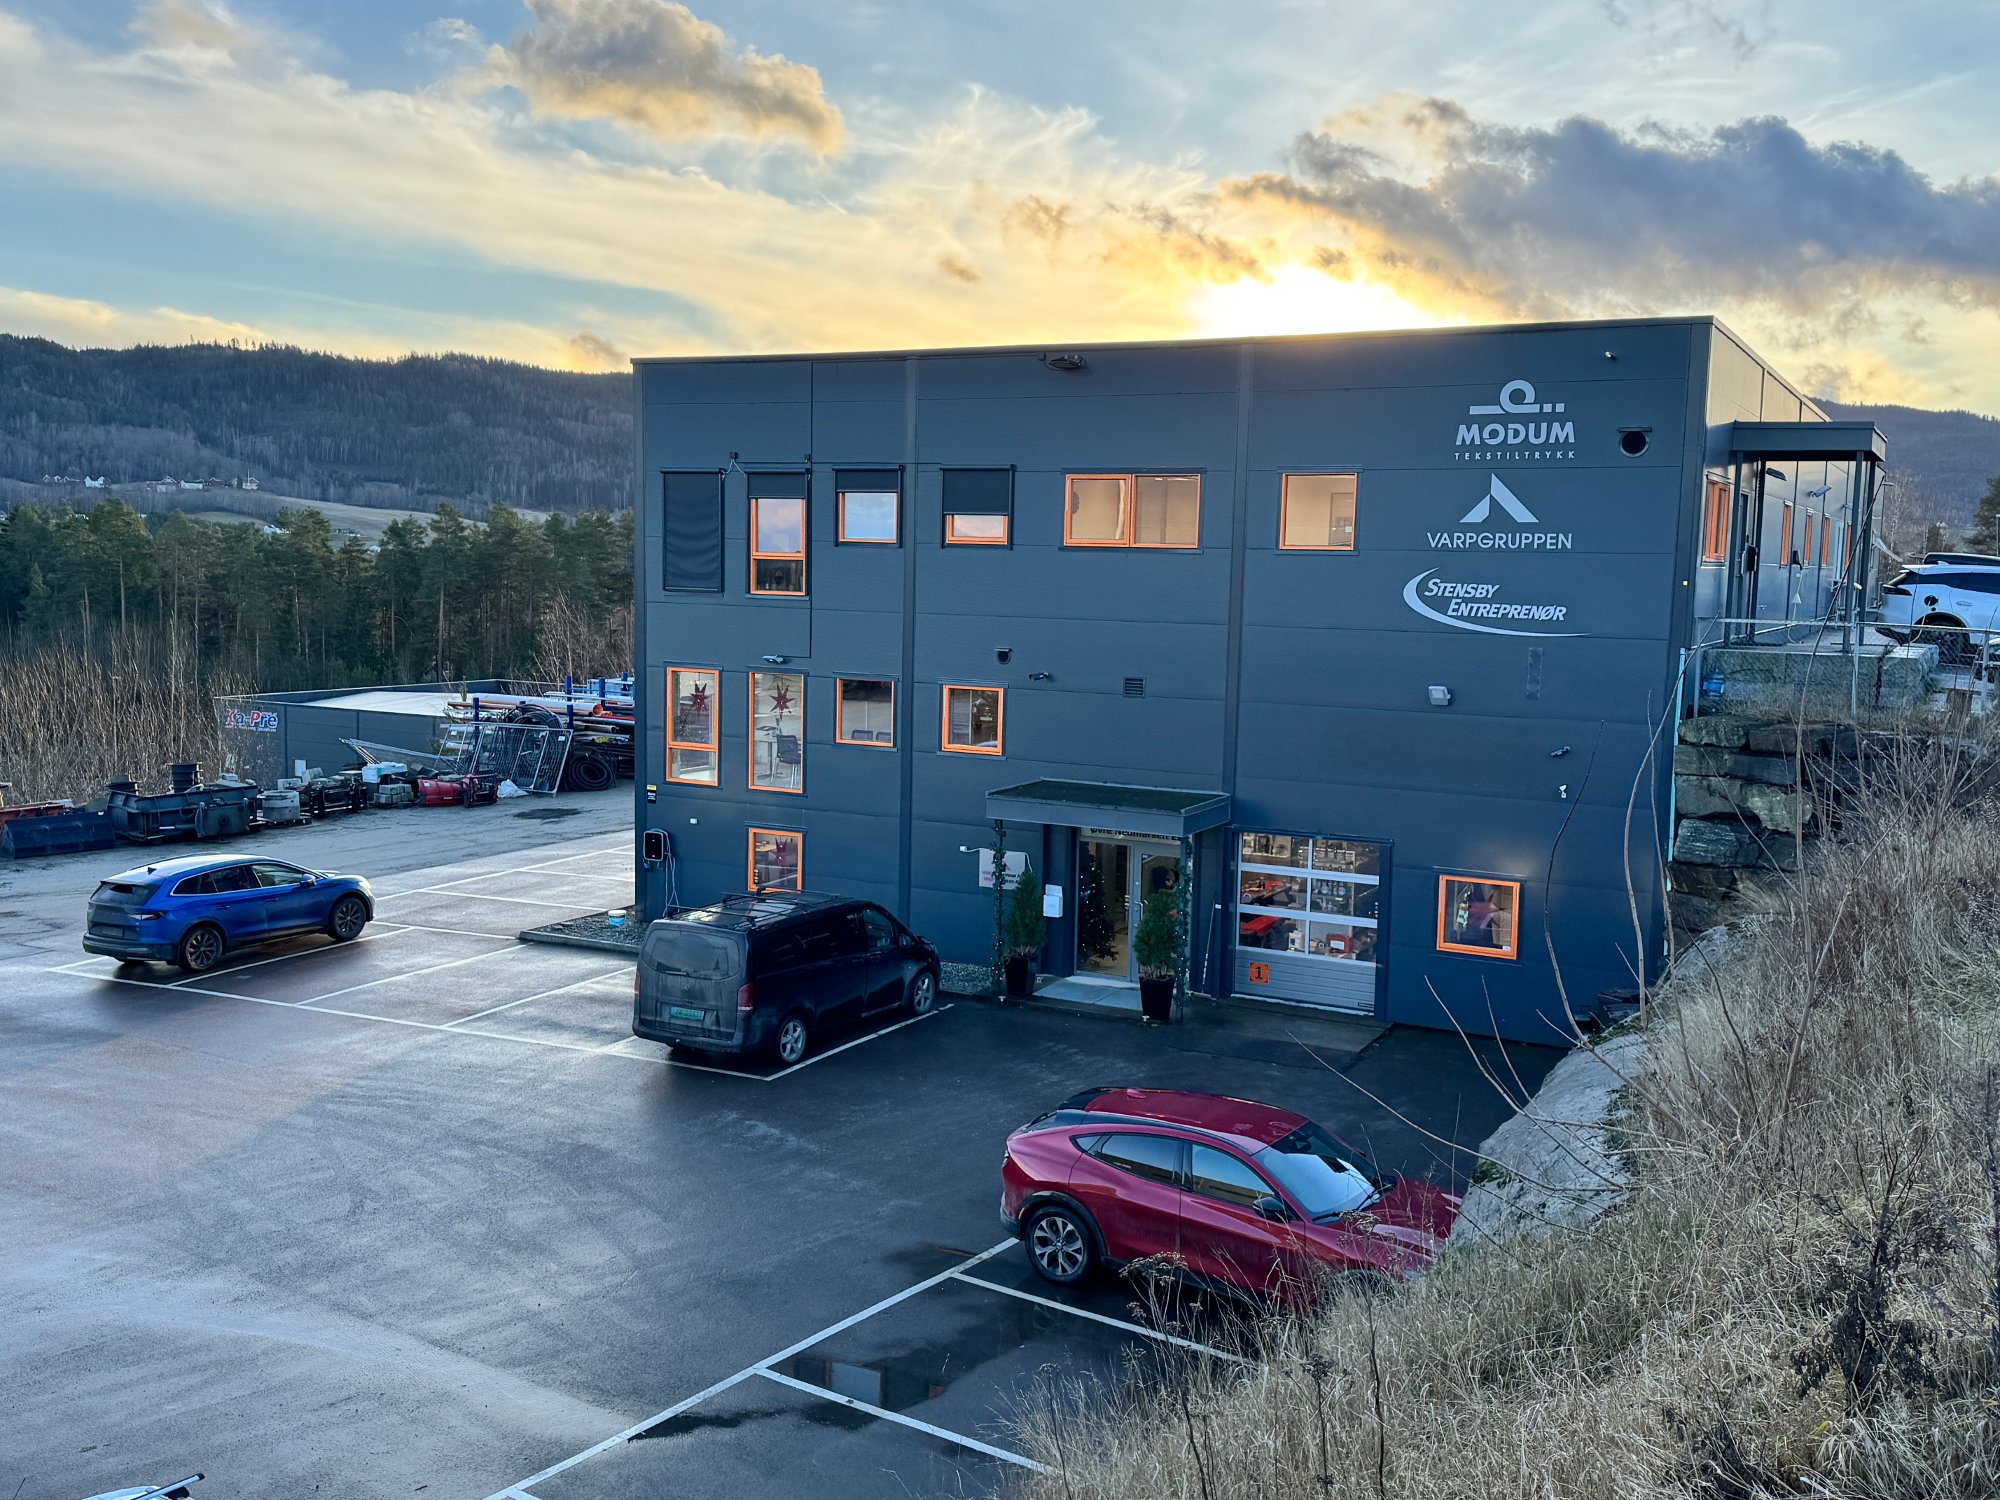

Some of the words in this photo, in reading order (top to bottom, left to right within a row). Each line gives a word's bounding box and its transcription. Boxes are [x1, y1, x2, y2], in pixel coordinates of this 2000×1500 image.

[1455, 421, 1575, 446] MODUM
[1454, 450, 1576, 461] TEKSTILTRYKK
[1427, 532, 1572, 550] VARPGRUPPEN
[1424, 578, 1500, 599] STENSBY
[1447, 599, 1567, 621] ENTREPRENØR
[1255, 966, 1263, 980] 1
